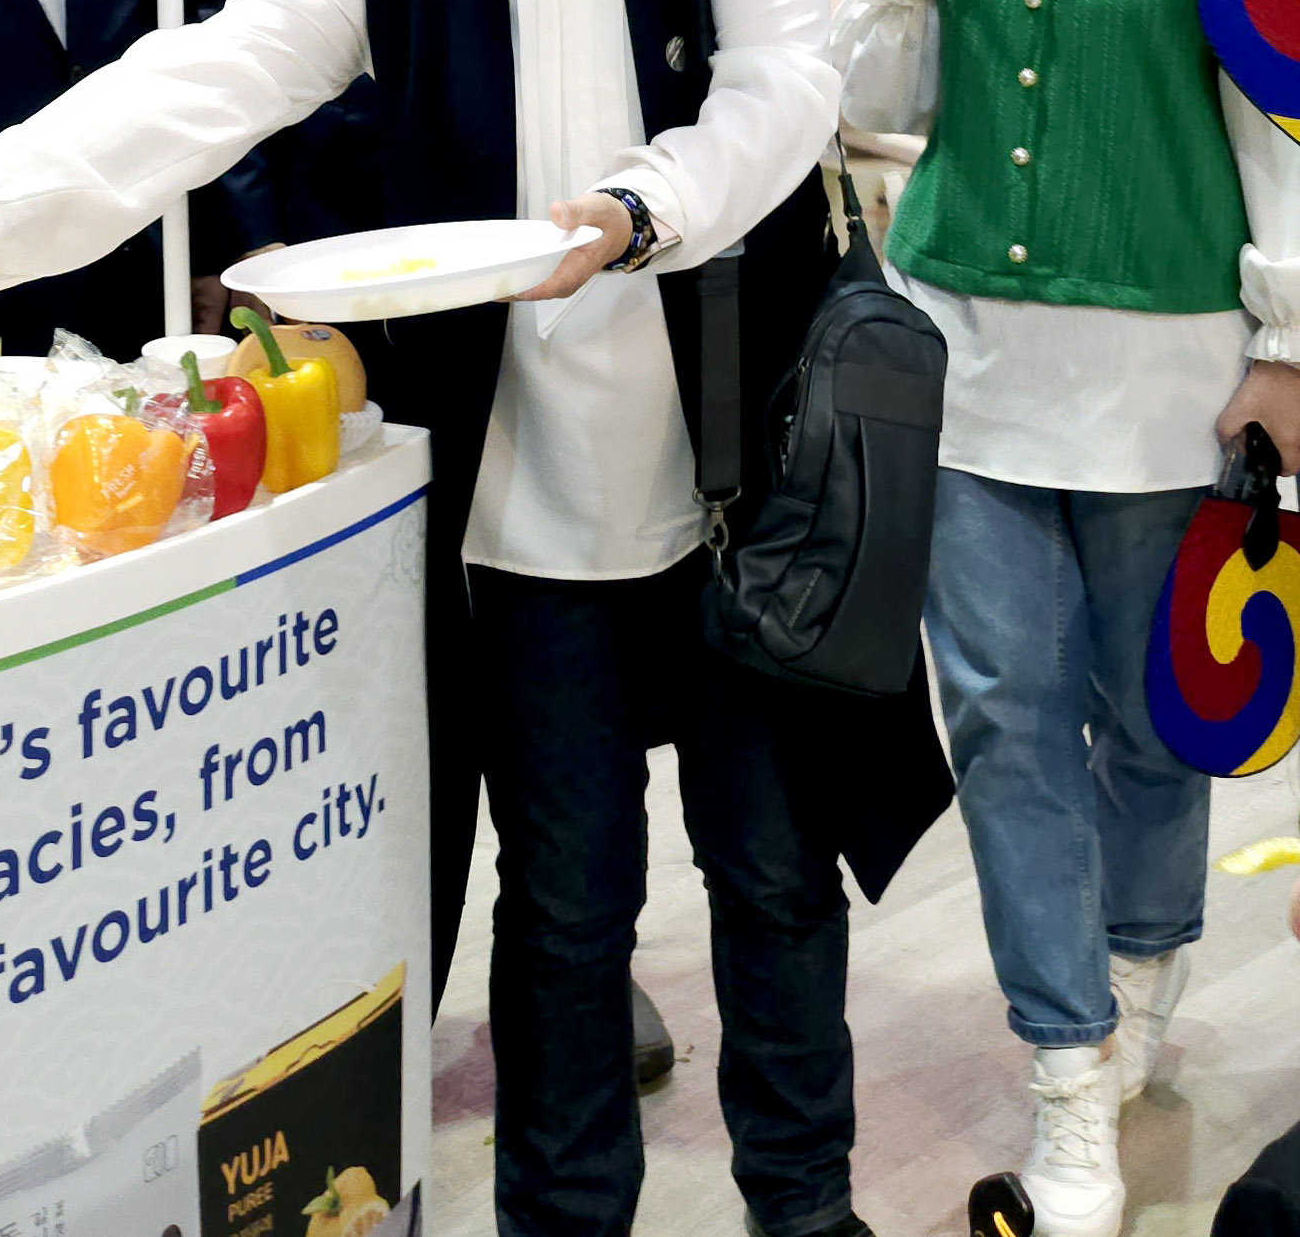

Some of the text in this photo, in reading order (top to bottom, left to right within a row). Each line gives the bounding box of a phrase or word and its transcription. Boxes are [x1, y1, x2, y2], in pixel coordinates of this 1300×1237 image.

[78, 607, 339, 760] favourite
[198, 709, 328, 812] from
[292, 773, 385, 861] city.
[220, 1130, 290, 1195] YUJA
